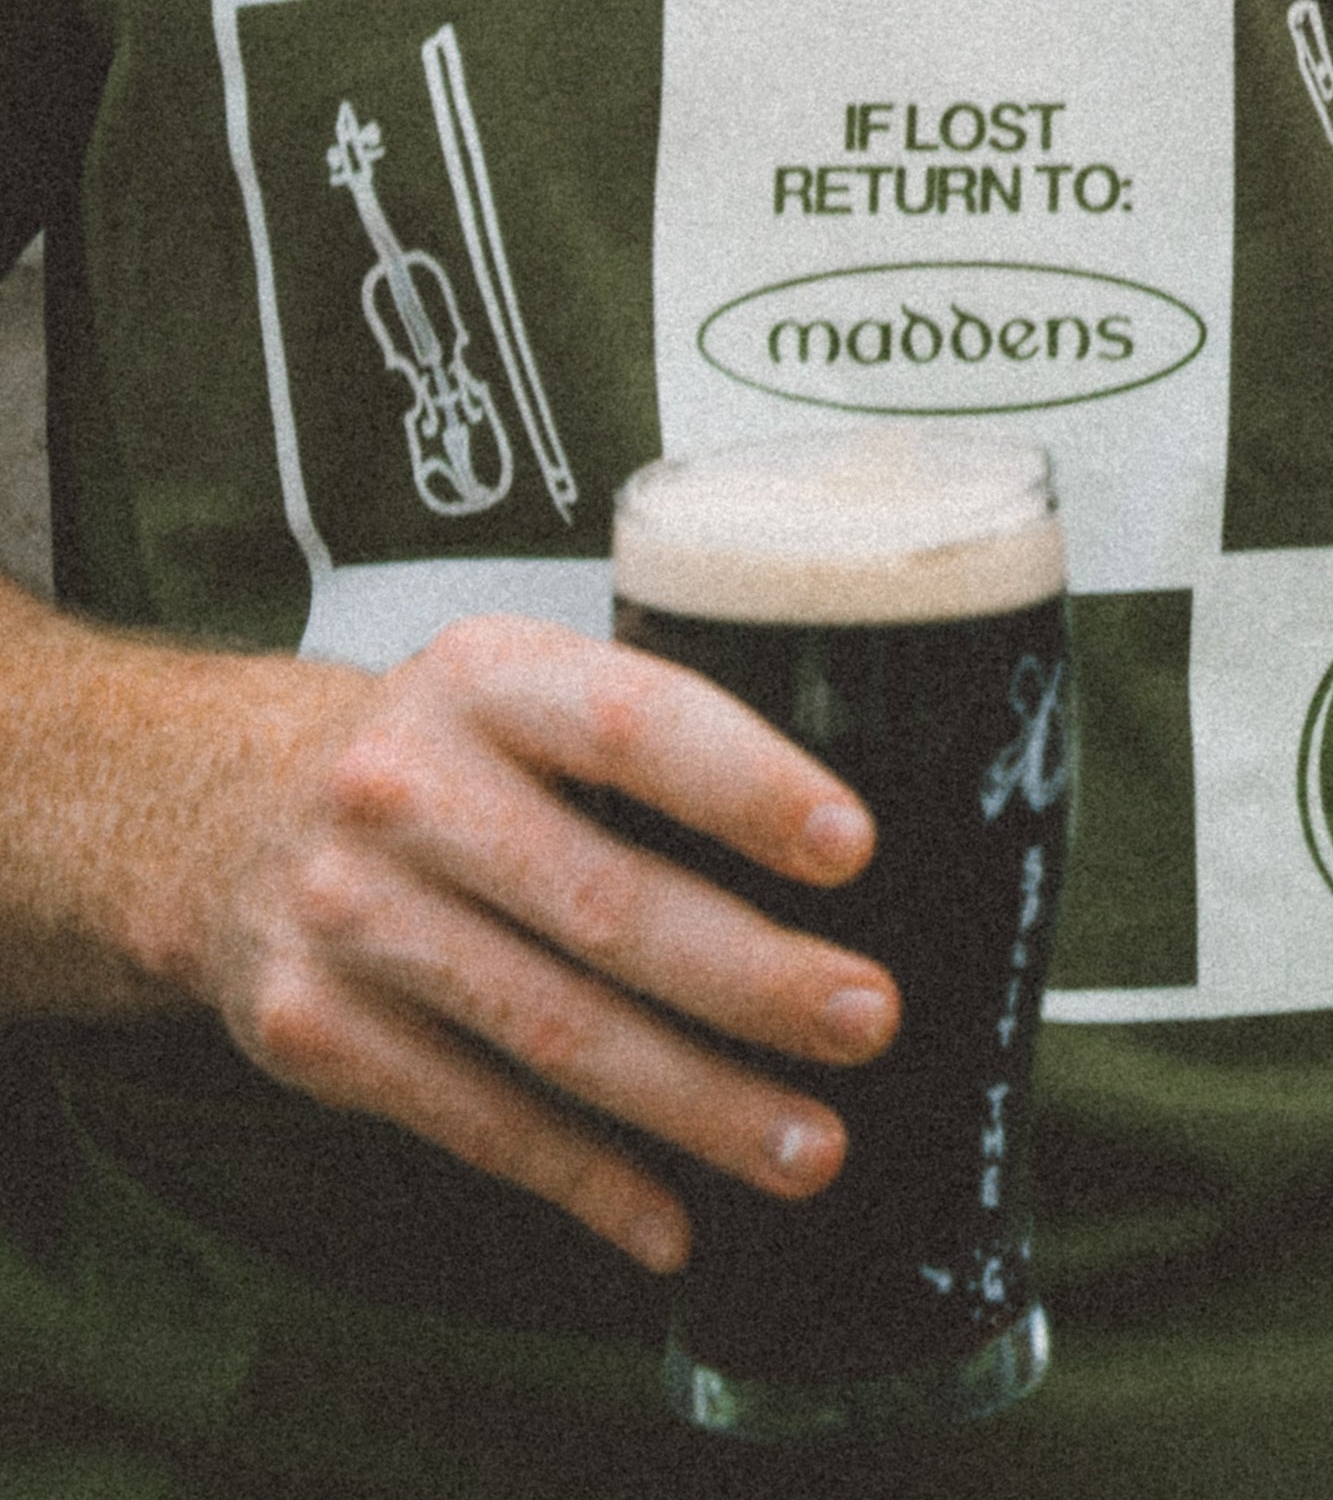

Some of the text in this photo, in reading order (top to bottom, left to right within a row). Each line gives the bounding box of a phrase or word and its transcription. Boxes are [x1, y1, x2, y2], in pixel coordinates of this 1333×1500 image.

[844, 101, 1066, 154] IF LOST
[773, 162, 1133, 216] RETURN TO:
[767, 303, 1135, 367] maddens
